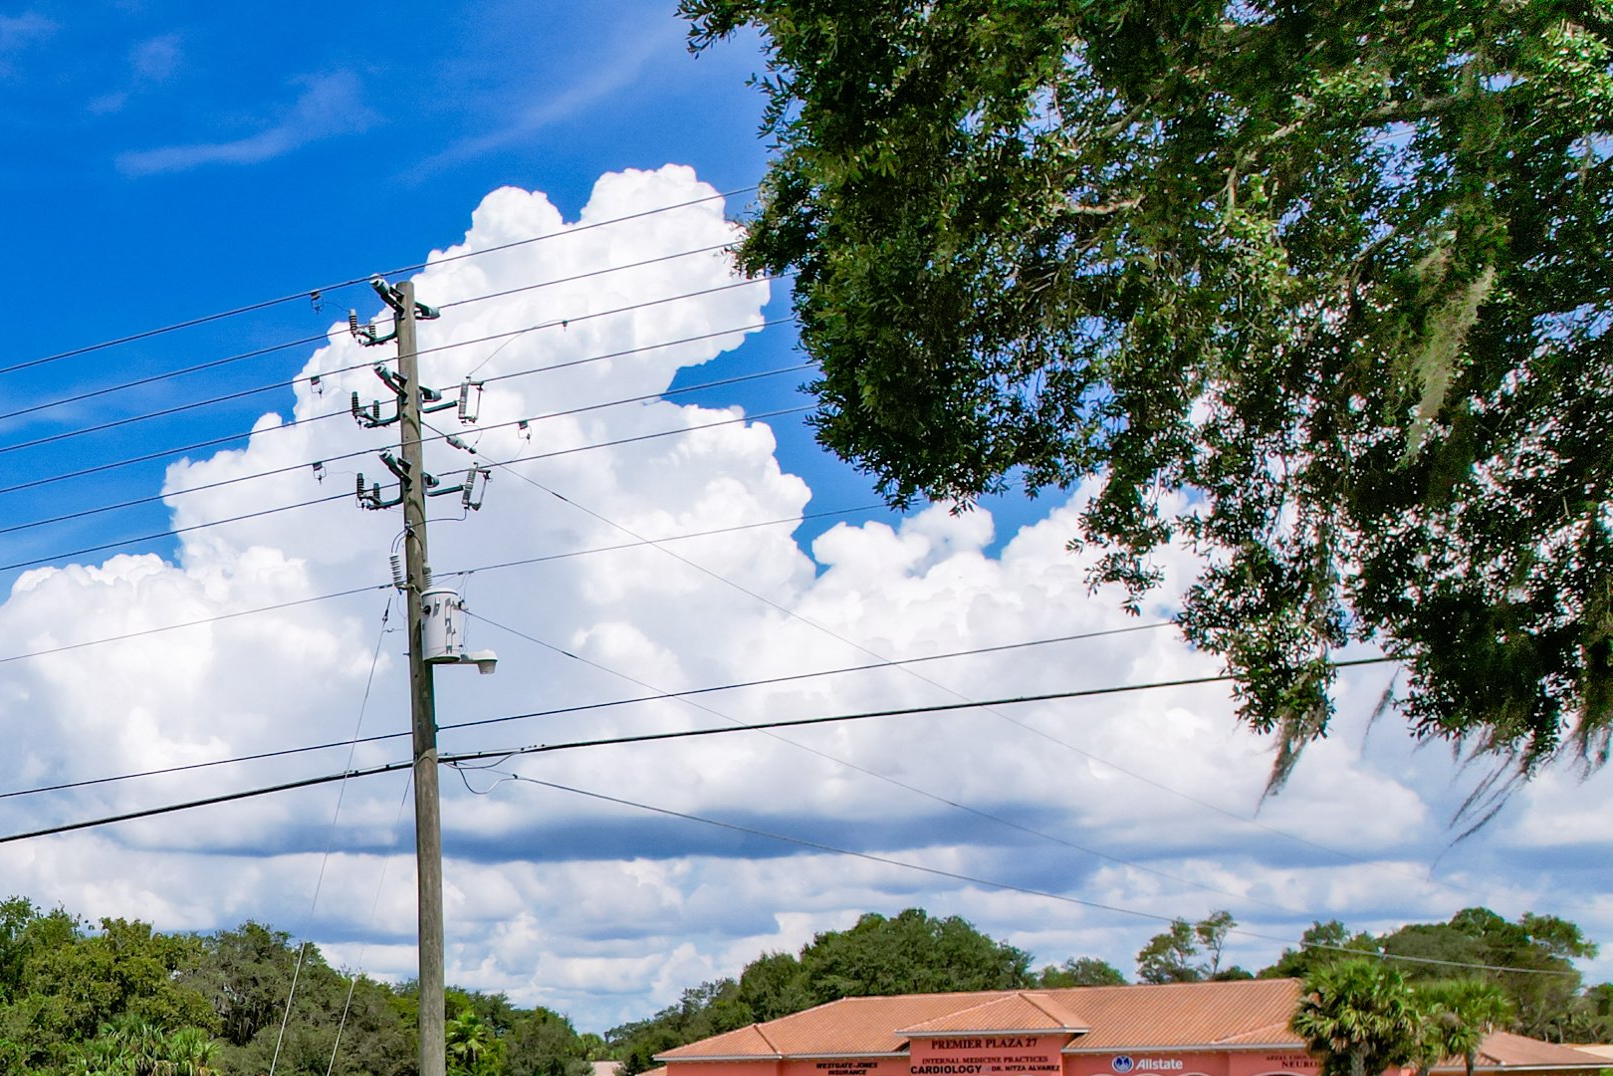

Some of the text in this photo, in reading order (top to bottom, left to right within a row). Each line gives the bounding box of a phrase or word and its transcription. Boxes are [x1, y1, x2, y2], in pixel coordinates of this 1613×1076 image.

[931, 1038, 1037, 1050] PREMIER PLAZA 27
[910, 1065, 982, 1075] CARDIOLOGY
[1136, 1058, 1183, 1070] Allstate
